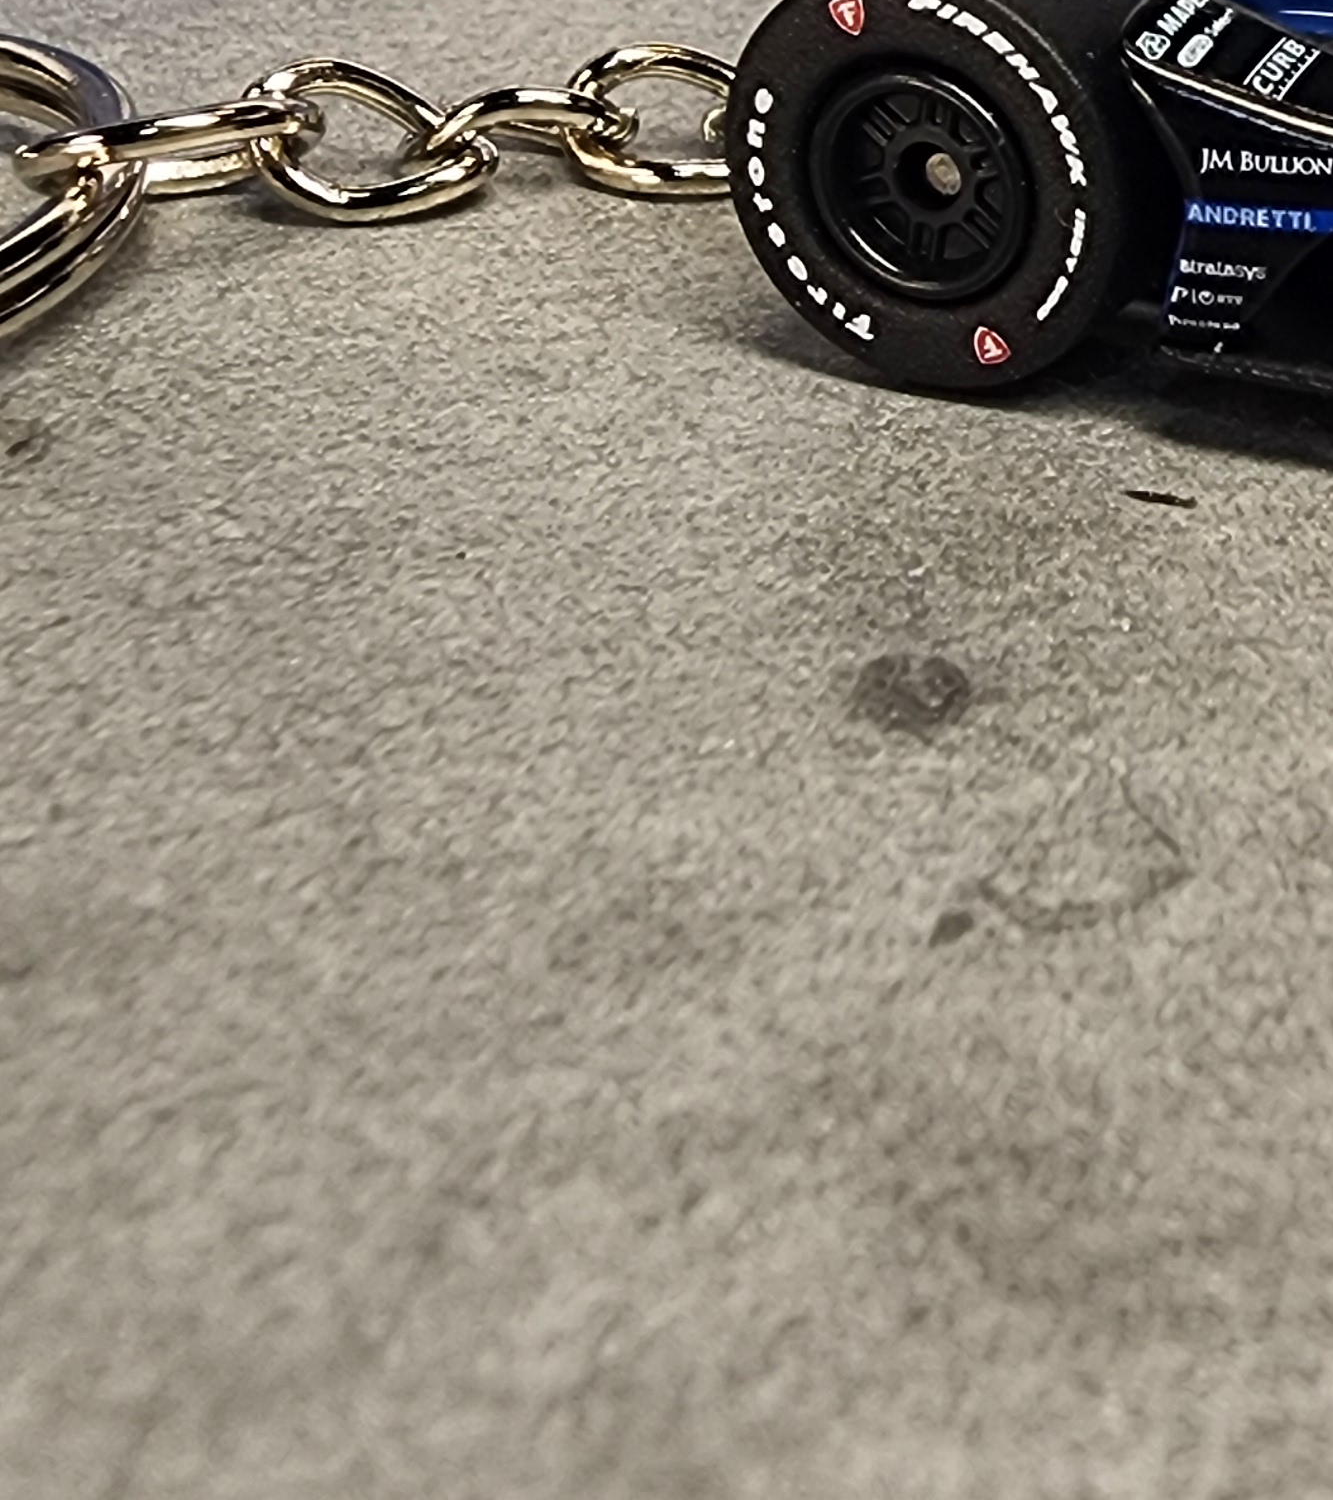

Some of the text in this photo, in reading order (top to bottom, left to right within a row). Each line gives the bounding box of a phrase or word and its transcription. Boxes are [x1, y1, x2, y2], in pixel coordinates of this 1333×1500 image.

[1252, 39, 1306, 95] CURB
[1200, 148, 1234, 174] JM
[1187, 203, 1313, 231] ANDRETTI
